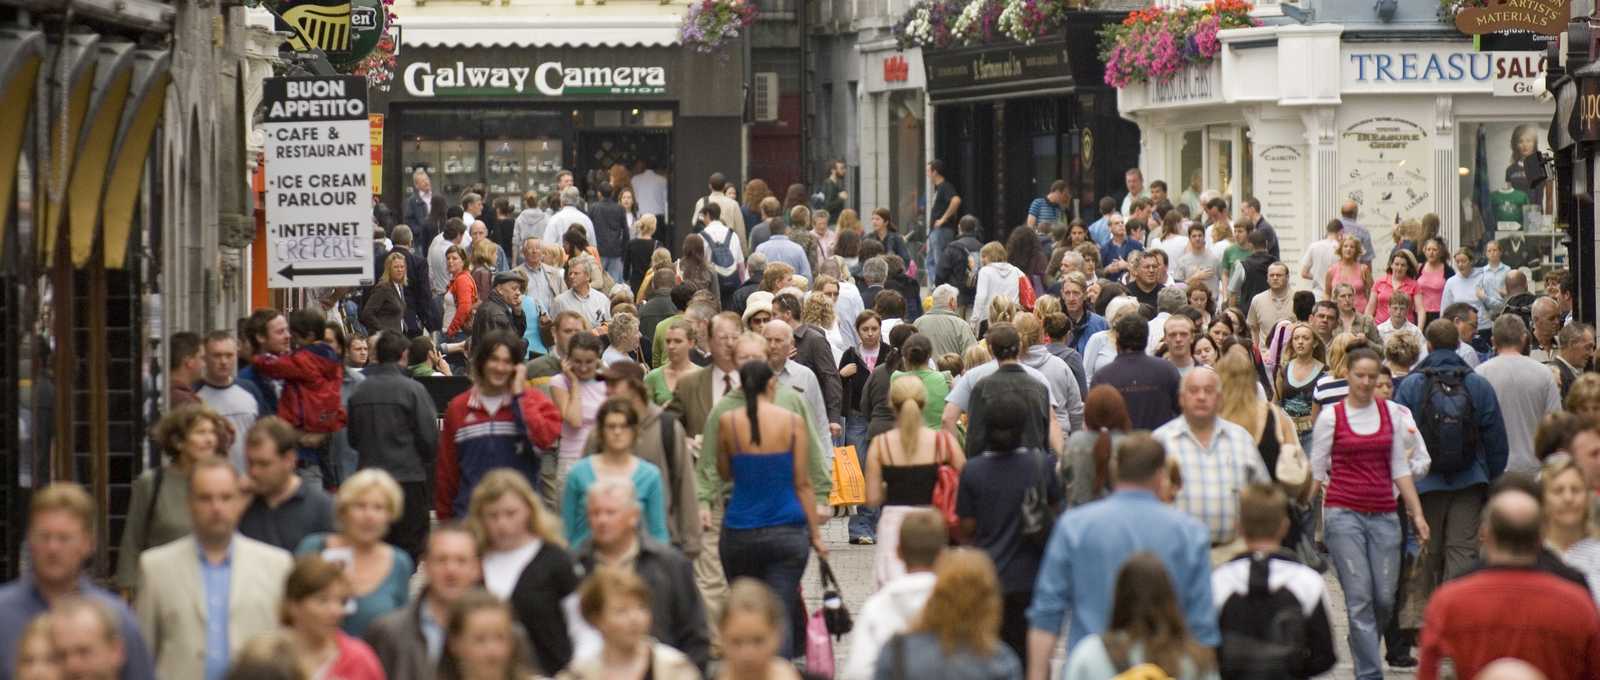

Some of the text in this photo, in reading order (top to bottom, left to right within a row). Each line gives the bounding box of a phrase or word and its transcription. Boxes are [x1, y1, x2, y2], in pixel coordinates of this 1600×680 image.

[1476, 11, 1548, 26] MATERIALS
[1350, 53, 1493, 81] TREASU
[403, 61, 665, 97] Galway Camera
[287, 80, 345, 99] BUON
[269, 98, 364, 118] APPETITO
[276, 126, 339, 141] CAFE &
[276, 143, 365, 159] RESTAURANT
[277, 173, 366, 189] ICE CREAM
[278, 192, 357, 207] PARLOUR
[279, 222, 360, 238] INTERNET
